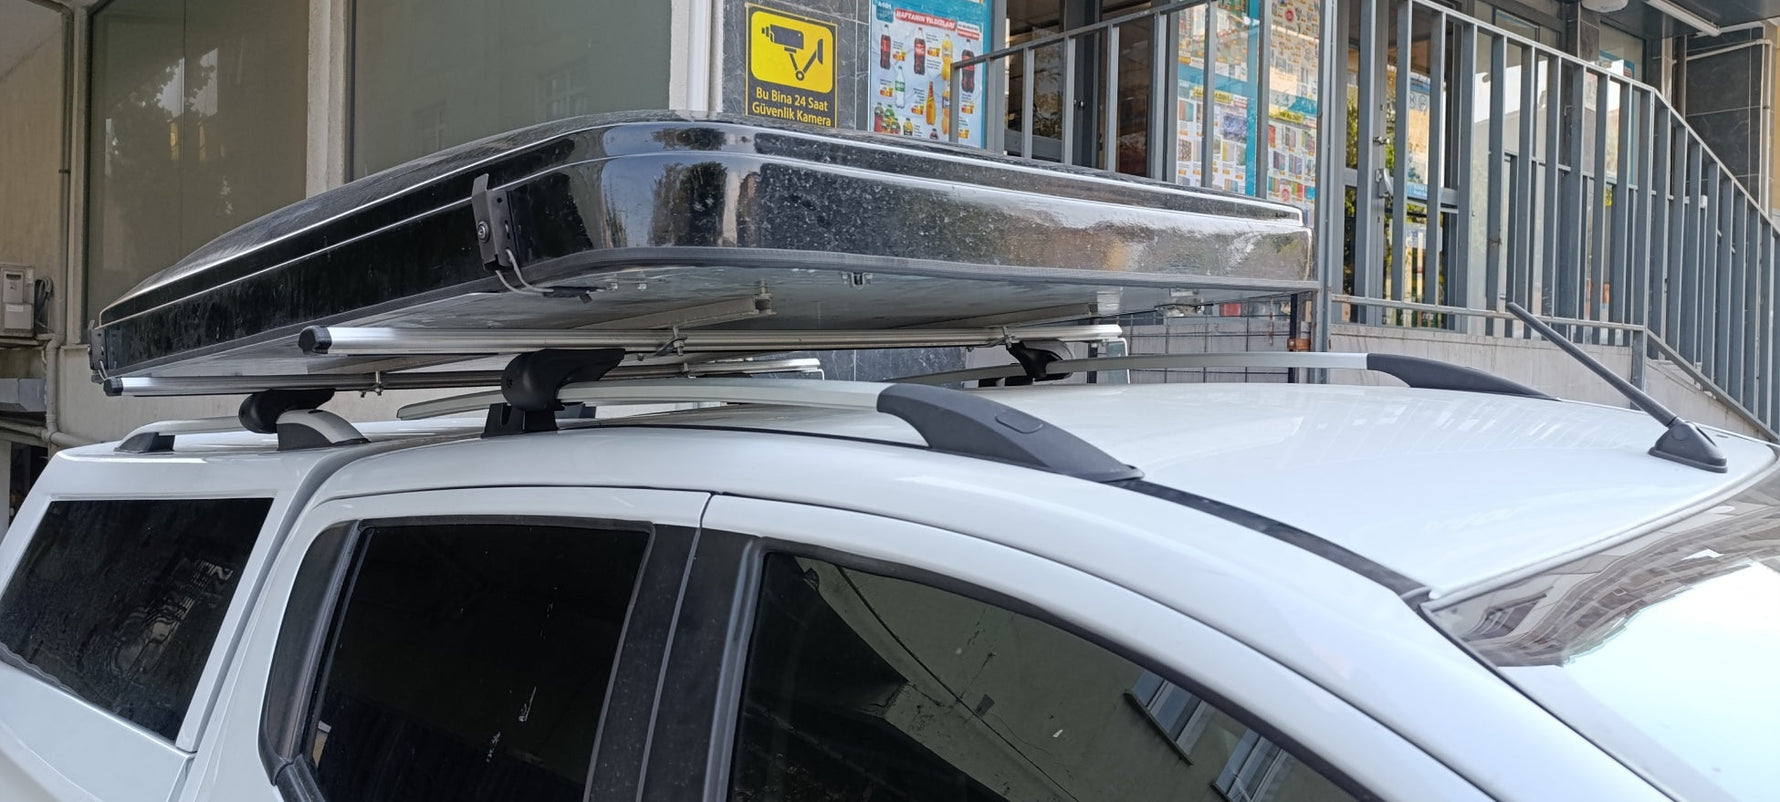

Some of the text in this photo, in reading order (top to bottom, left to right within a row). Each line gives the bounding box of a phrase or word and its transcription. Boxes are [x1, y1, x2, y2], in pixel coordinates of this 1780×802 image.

[756, 87, 828, 111] Bu Bina 24 Saat
[752, 102, 831, 126] Güvenlik Kamera
